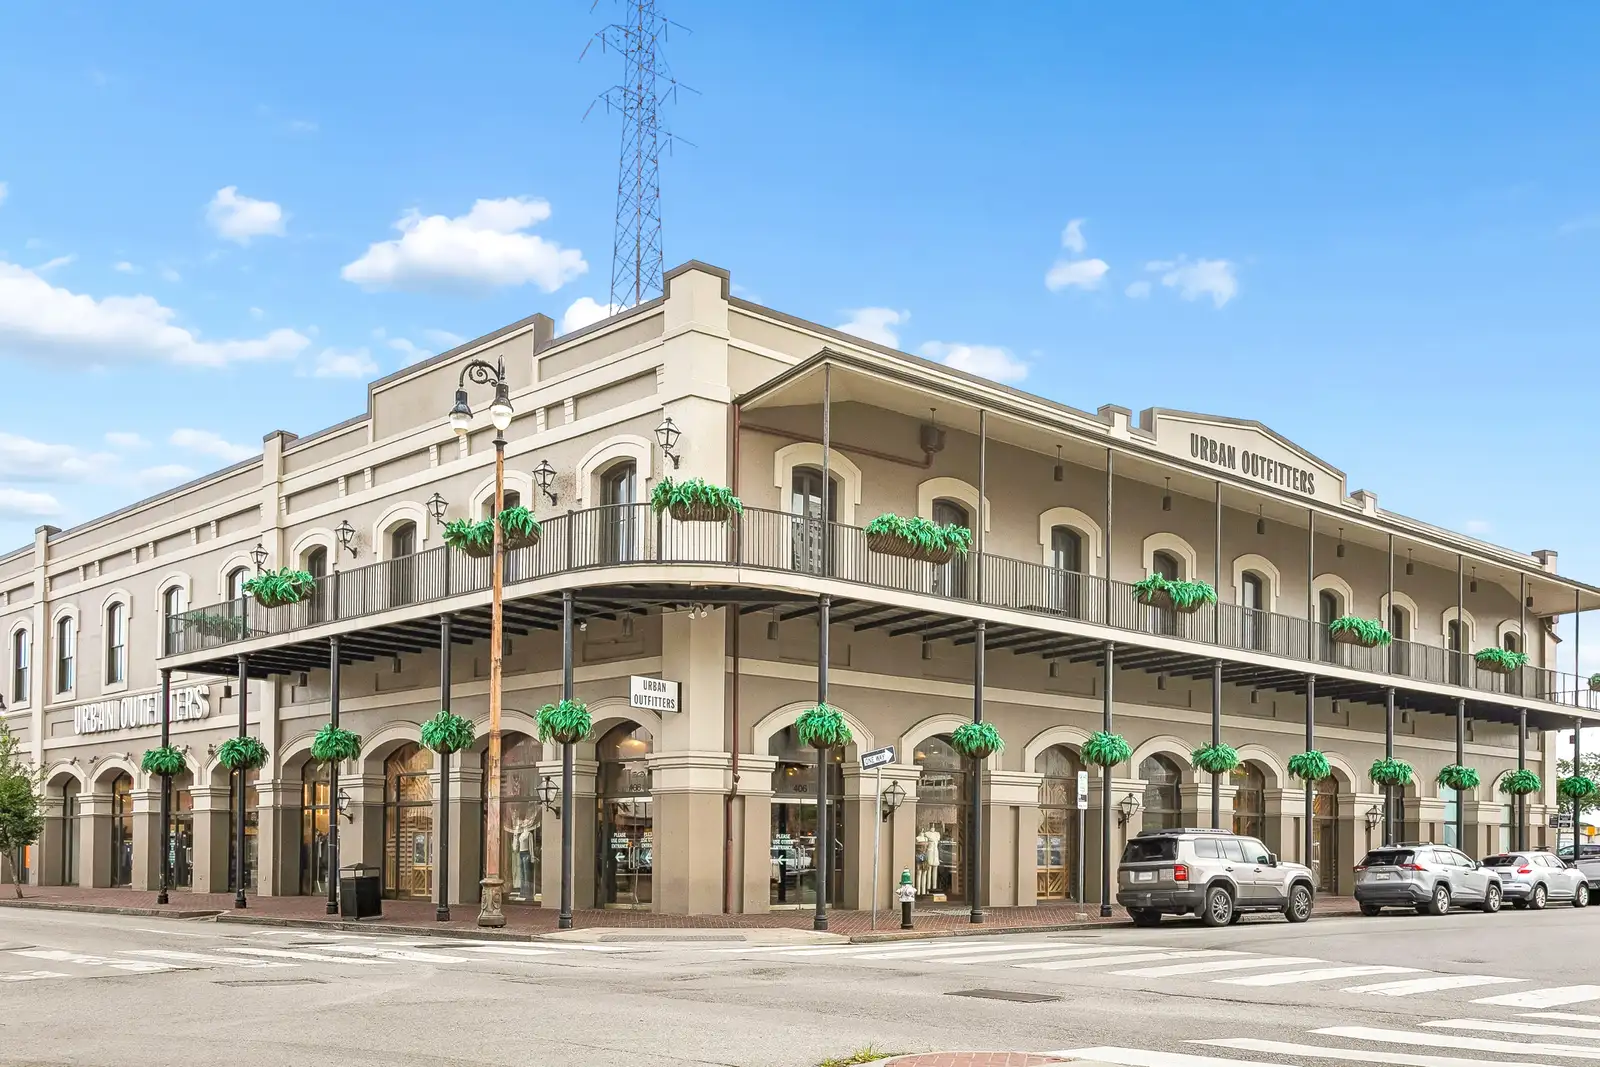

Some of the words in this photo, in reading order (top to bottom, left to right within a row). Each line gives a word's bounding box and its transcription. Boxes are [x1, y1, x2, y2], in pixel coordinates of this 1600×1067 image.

[1191, 433, 1236, 470] URBAN
[1241, 450, 1315, 495] OUTFITTERS
[643, 679, 667, 693] URBAN
[633, 693, 675, 709] OUTFITTERS
[74, 699, 119, 735] URBAN
[876, 753, 885, 761] WAY
[793, 784, 808, 793] 406
